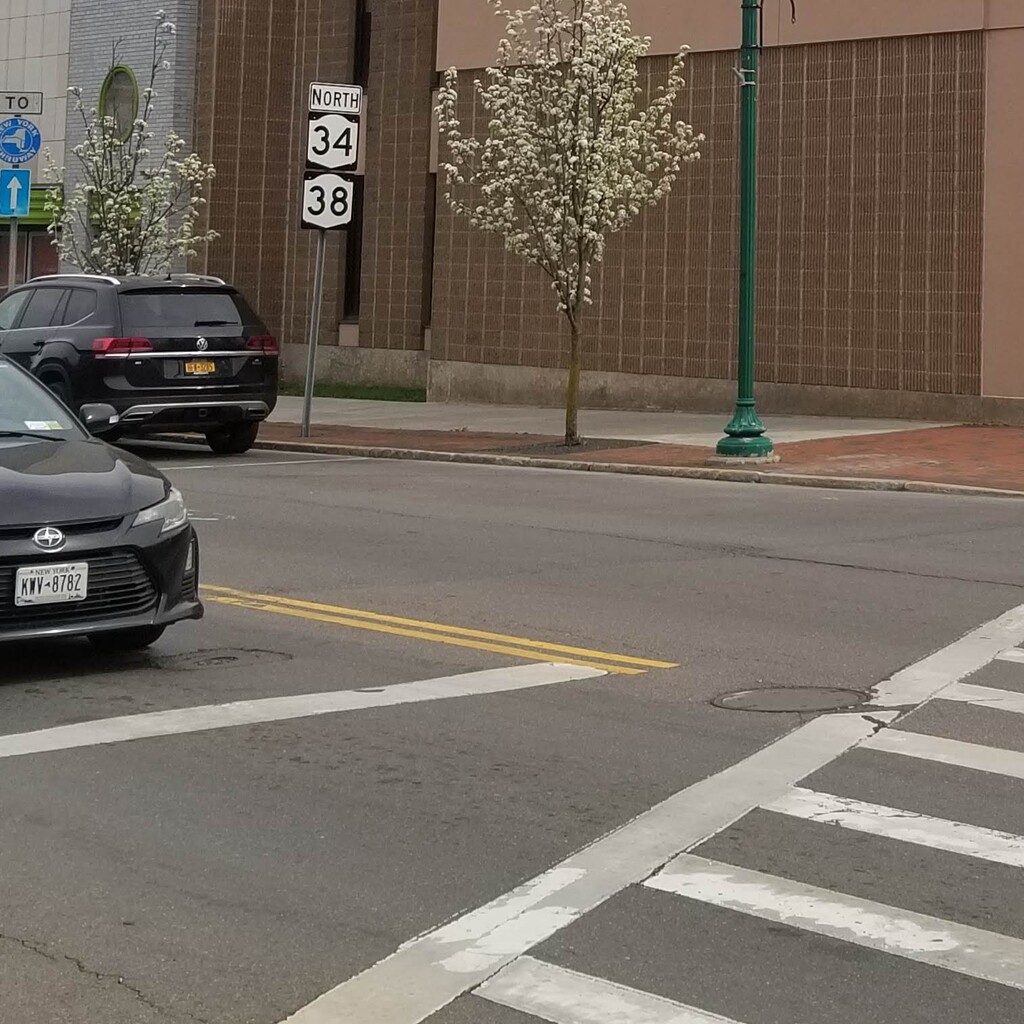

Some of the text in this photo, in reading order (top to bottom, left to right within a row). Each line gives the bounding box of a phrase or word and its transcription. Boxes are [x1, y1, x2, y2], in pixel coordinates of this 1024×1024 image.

[5, 97, 28, 109] TO
[312, 88, 360, 109] NORTH
[17, 119, 39, 136] YORK
[311, 125, 353, 157] 34
[307, 185, 349, 217] 38
[52, 574, 82, 593] 8782
